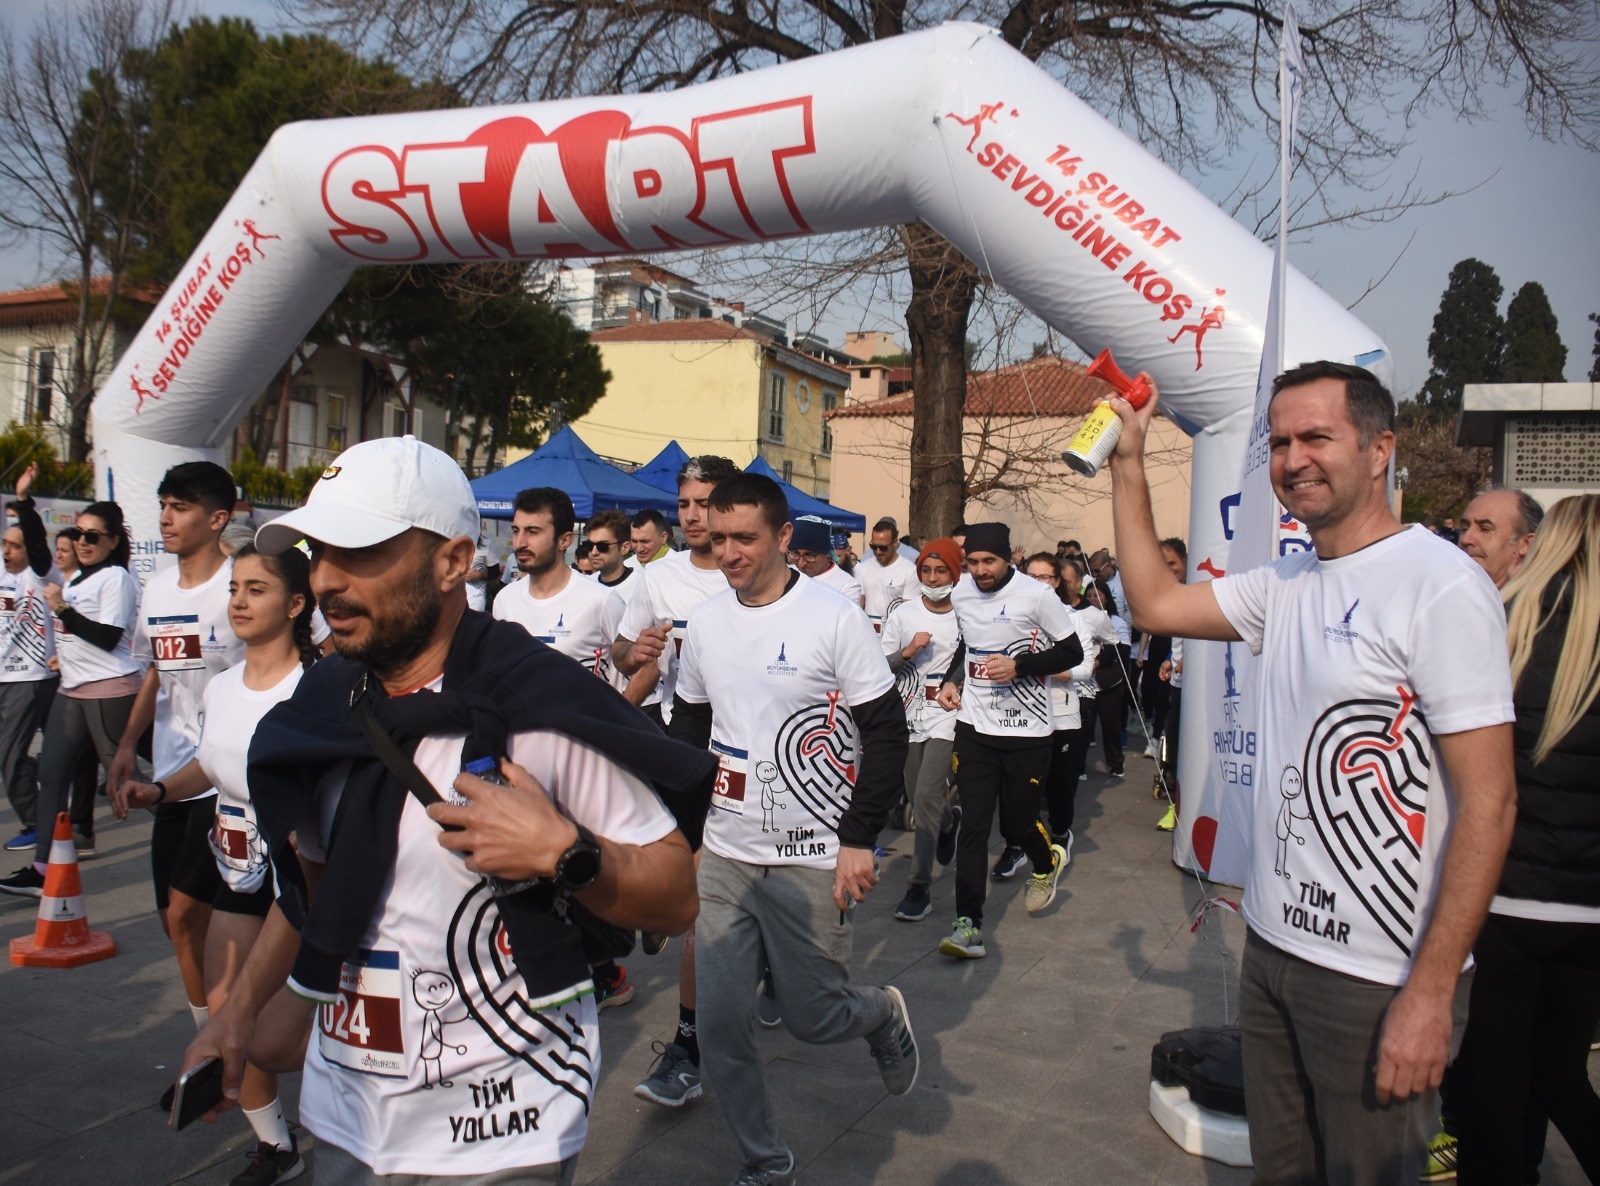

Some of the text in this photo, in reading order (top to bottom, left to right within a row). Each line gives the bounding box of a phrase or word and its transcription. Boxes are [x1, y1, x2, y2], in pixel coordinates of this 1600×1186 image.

[322, 95, 816, 262] START
[1046, 144, 1182, 249] 14 ŞUBAT
[976, 141, 1194, 322] SEVDİĞİNE KOŞ
[155, 253, 213, 344] 14 ŞUBAT
[152, 242, 253, 393] SEVDİĞİNE KOŞ
[156, 637, 187, 659] 012
[998, 719, 1028, 728] YOLLAR
[1005, 708, 1021, 718] TÜM
[775, 843, 826, 858] YOLLAR
[787, 826, 814, 842] TÜM
[1300, 881, 1337, 914] TÜM
[1283, 902, 1351, 945] YOLLAR
[468, 1076, 516, 1109] TÜM
[449, 1107, 540, 1144] YOLLAR
